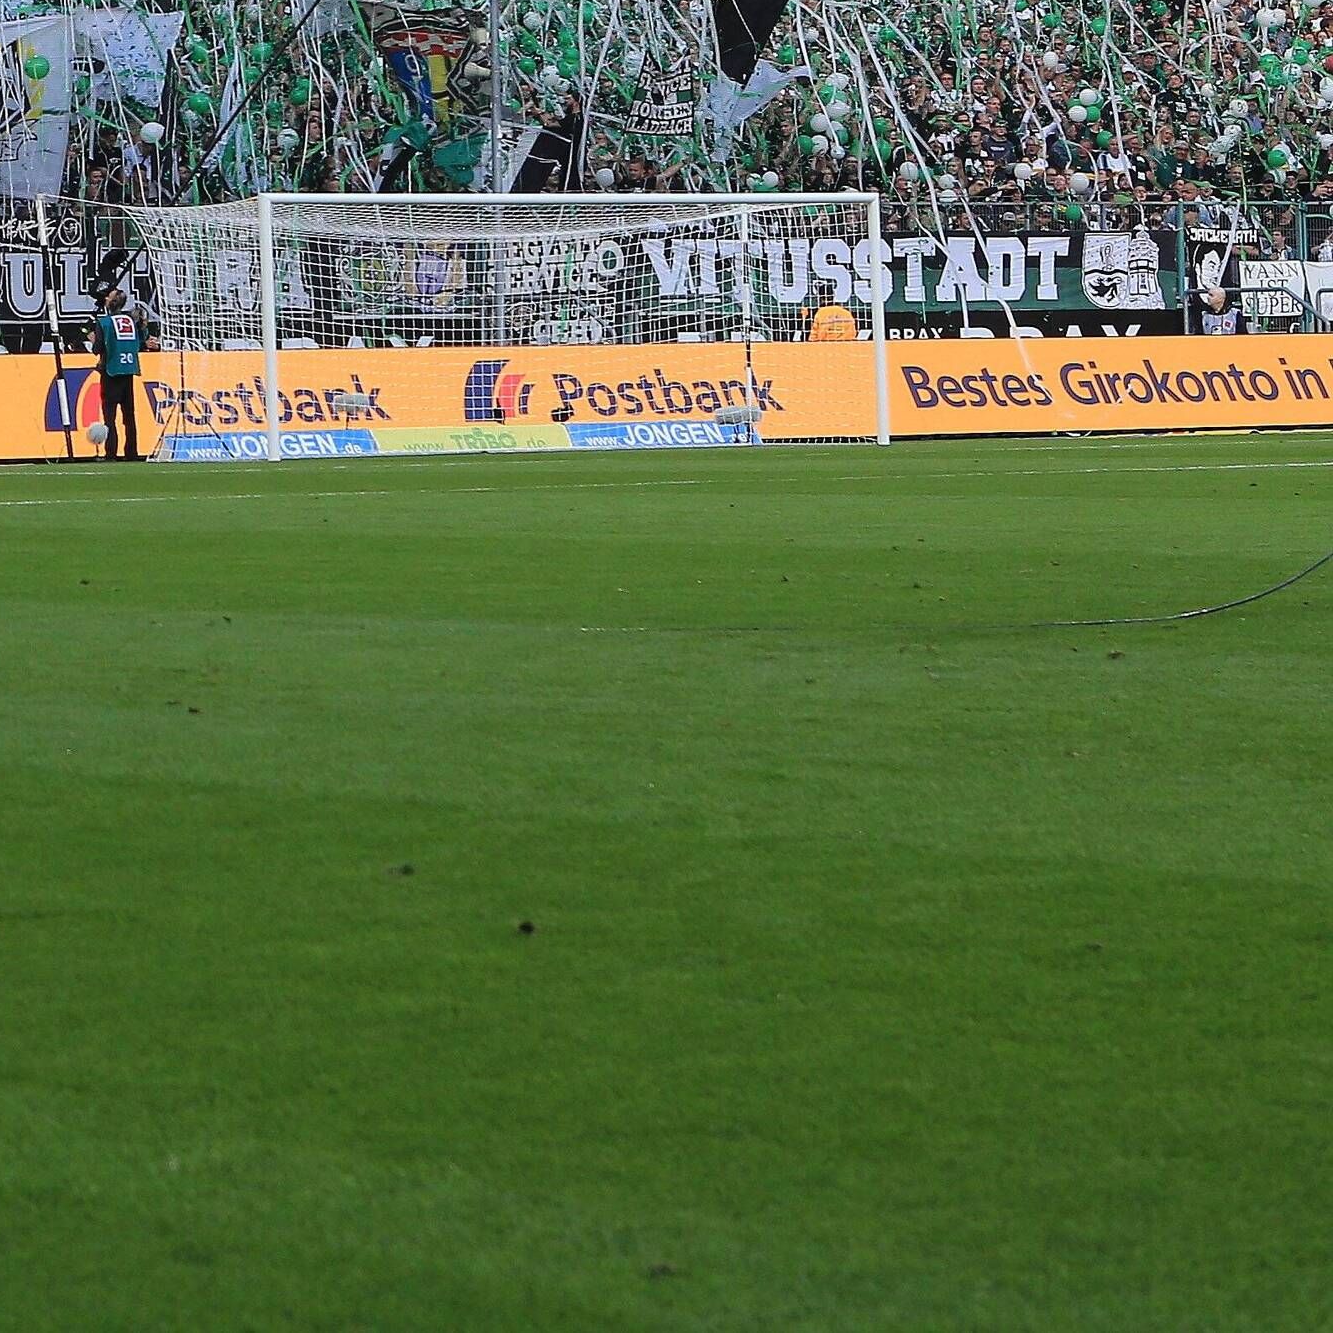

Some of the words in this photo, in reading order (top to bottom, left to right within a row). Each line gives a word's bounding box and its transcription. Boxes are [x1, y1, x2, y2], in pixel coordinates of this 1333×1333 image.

[1243, 262, 1300, 280] YANN
[1244, 296, 1301, 315] SUPER
[119, 353, 134, 365] 20
[551, 368, 786, 417] Postbank
[901, 365, 1053, 409] Bestes
[1060, 357, 1281, 404] Girokonto
[1285, 357, 1330, 400] in
